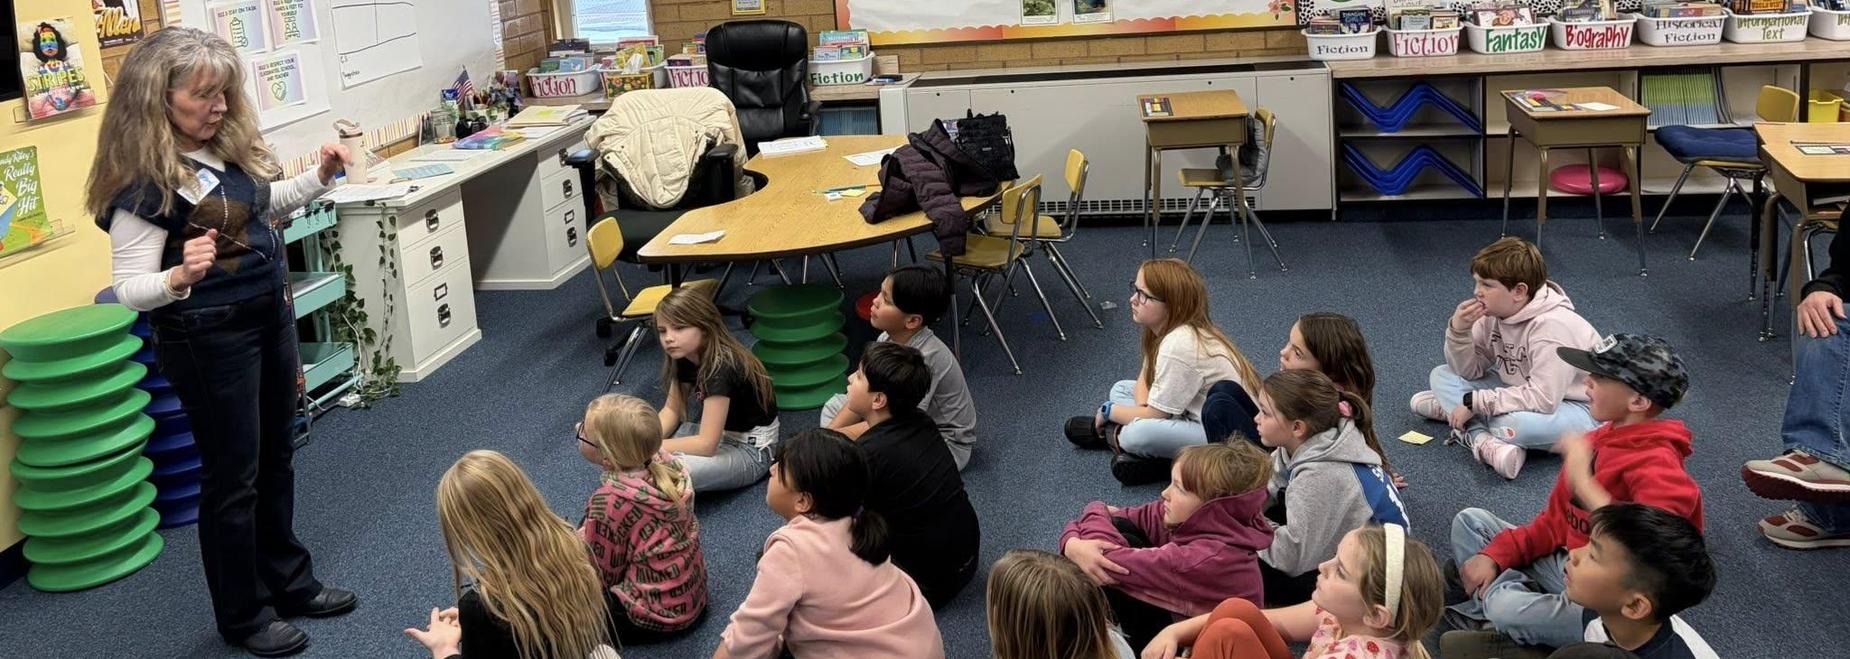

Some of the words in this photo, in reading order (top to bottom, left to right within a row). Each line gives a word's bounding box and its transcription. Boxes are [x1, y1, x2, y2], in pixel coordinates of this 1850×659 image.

[1655, 20, 1722, 30] Historical
[1737, 15, 1805, 29] Informational
[1485, 26, 1546, 52] Fantasy
[1565, 24, 1629, 48] Biography
[1664, 33, 1716, 43] Fiction
[1761, 28, 1785, 40] Text
[1317, 45, 1368, 55] Fiction
[1393, 32, 1459, 57] Fiction
[27, 67, 85, 92] STRIPES
[529, 75, 576, 98] Fiction
[810, 72, 864, 84] Fiction
[4, 162, 35, 181] Really
[16, 178, 38, 197] Big
[16, 195, 40, 217] Hit
